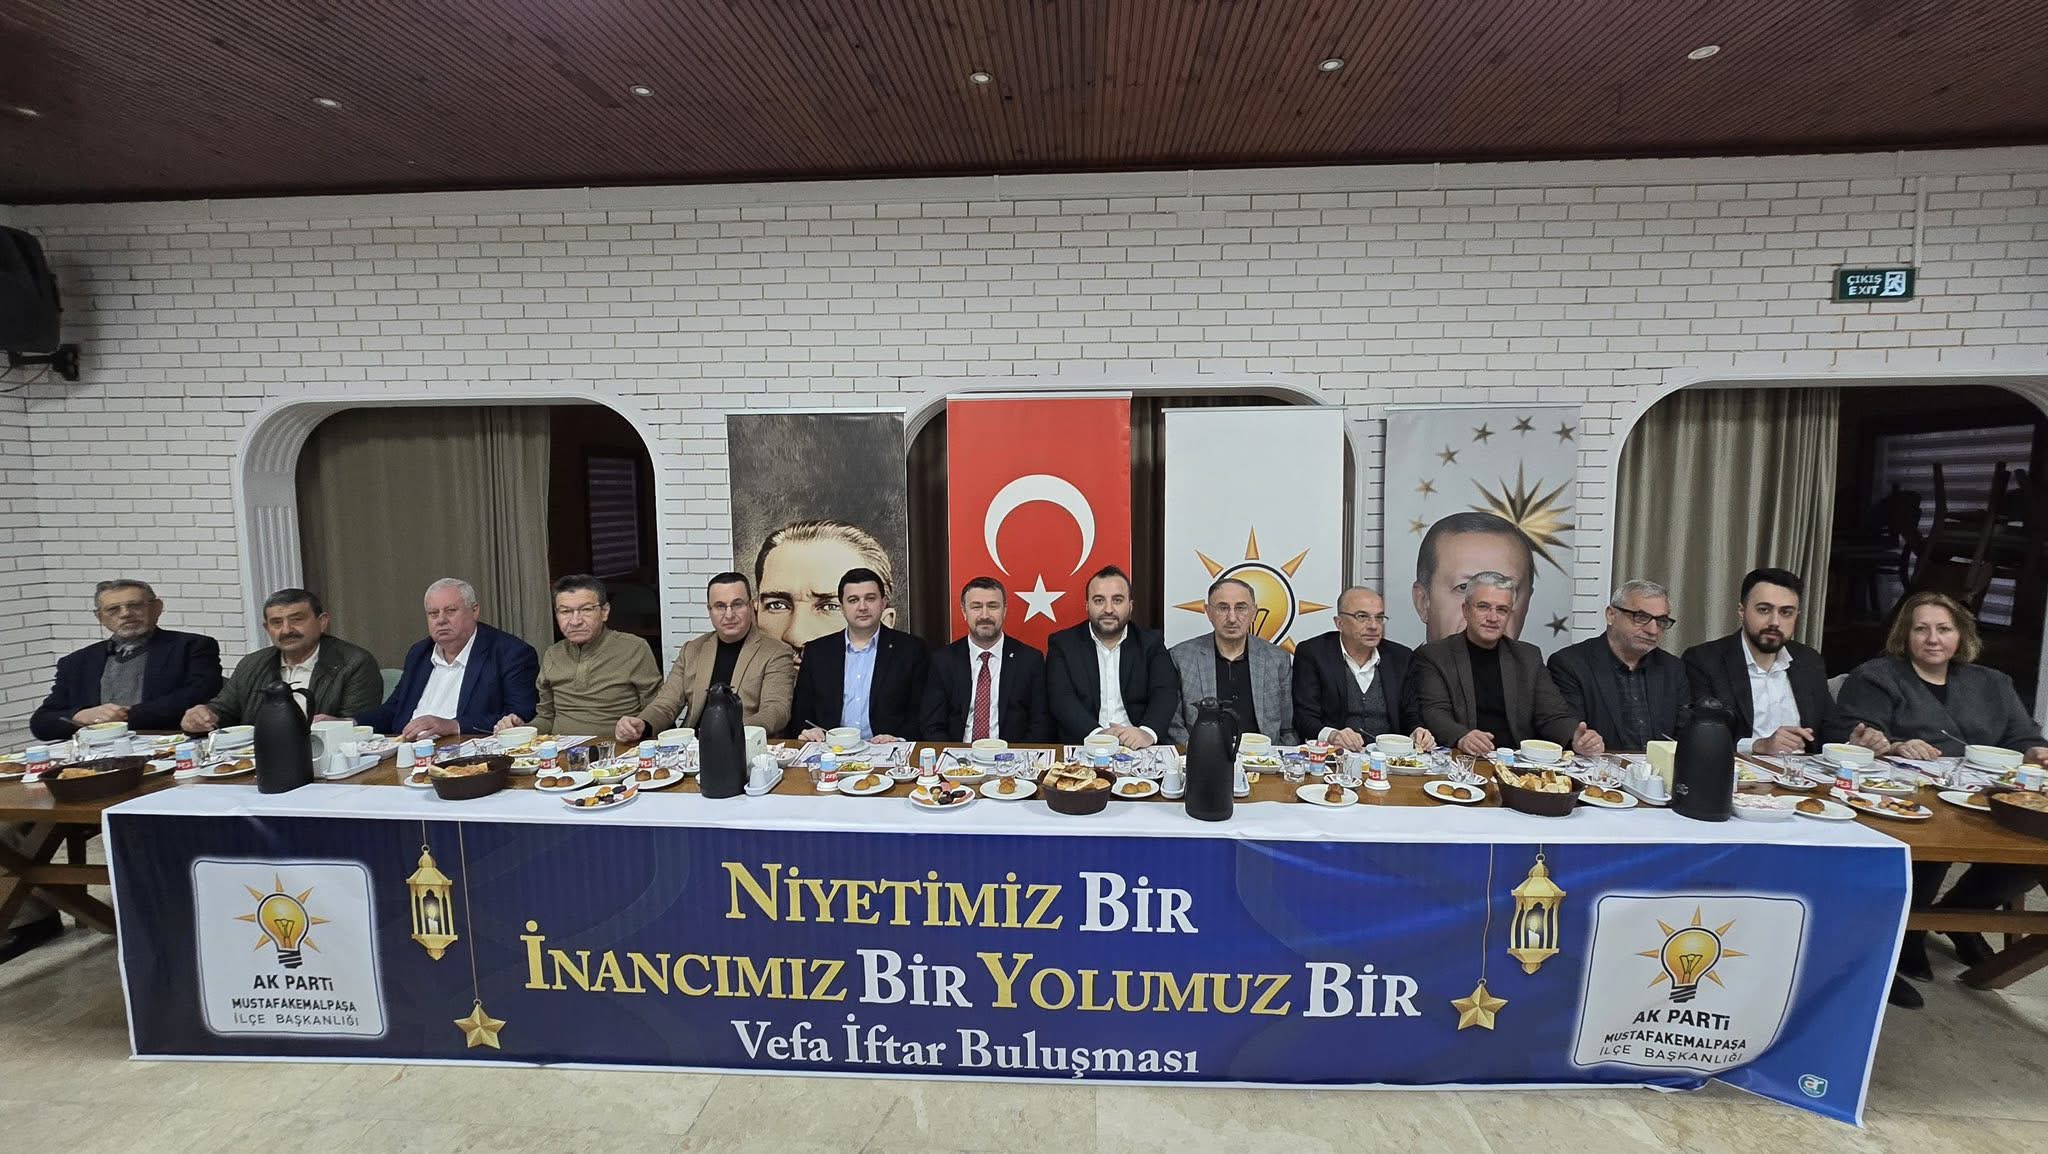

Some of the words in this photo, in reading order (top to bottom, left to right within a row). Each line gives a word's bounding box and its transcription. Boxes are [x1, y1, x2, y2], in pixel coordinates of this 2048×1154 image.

[1847, 274, 1882, 285] ÇIKIŞ
[1848, 285, 1880, 296] EXIT
[1079, 871, 1199, 933] BİR
[253, 974, 279, 989] AK
[856, 948, 973, 1008] BİR
[976, 952, 1292, 1015] YOLUMUZ
[1302, 961, 1421, 1017] BİR
[231, 998, 357, 1012] MUSTAFAKEMALPAŞA
[234, 1013, 266, 1026] İLÇE
[276, 1014, 360, 1027] BAŞKANLIĞI
[1632, 1009, 1662, 1024] AK
[730, 1020, 833, 1062] Vefa
[842, 1013, 947, 1066] İftar
[958, 1028, 1199, 1078] Buluşması
[1604, 1030, 1746, 1050] MUSTAFAKEMALPAŞA
[1644, 1047, 1743, 1064] BAŞKANLIĞI
